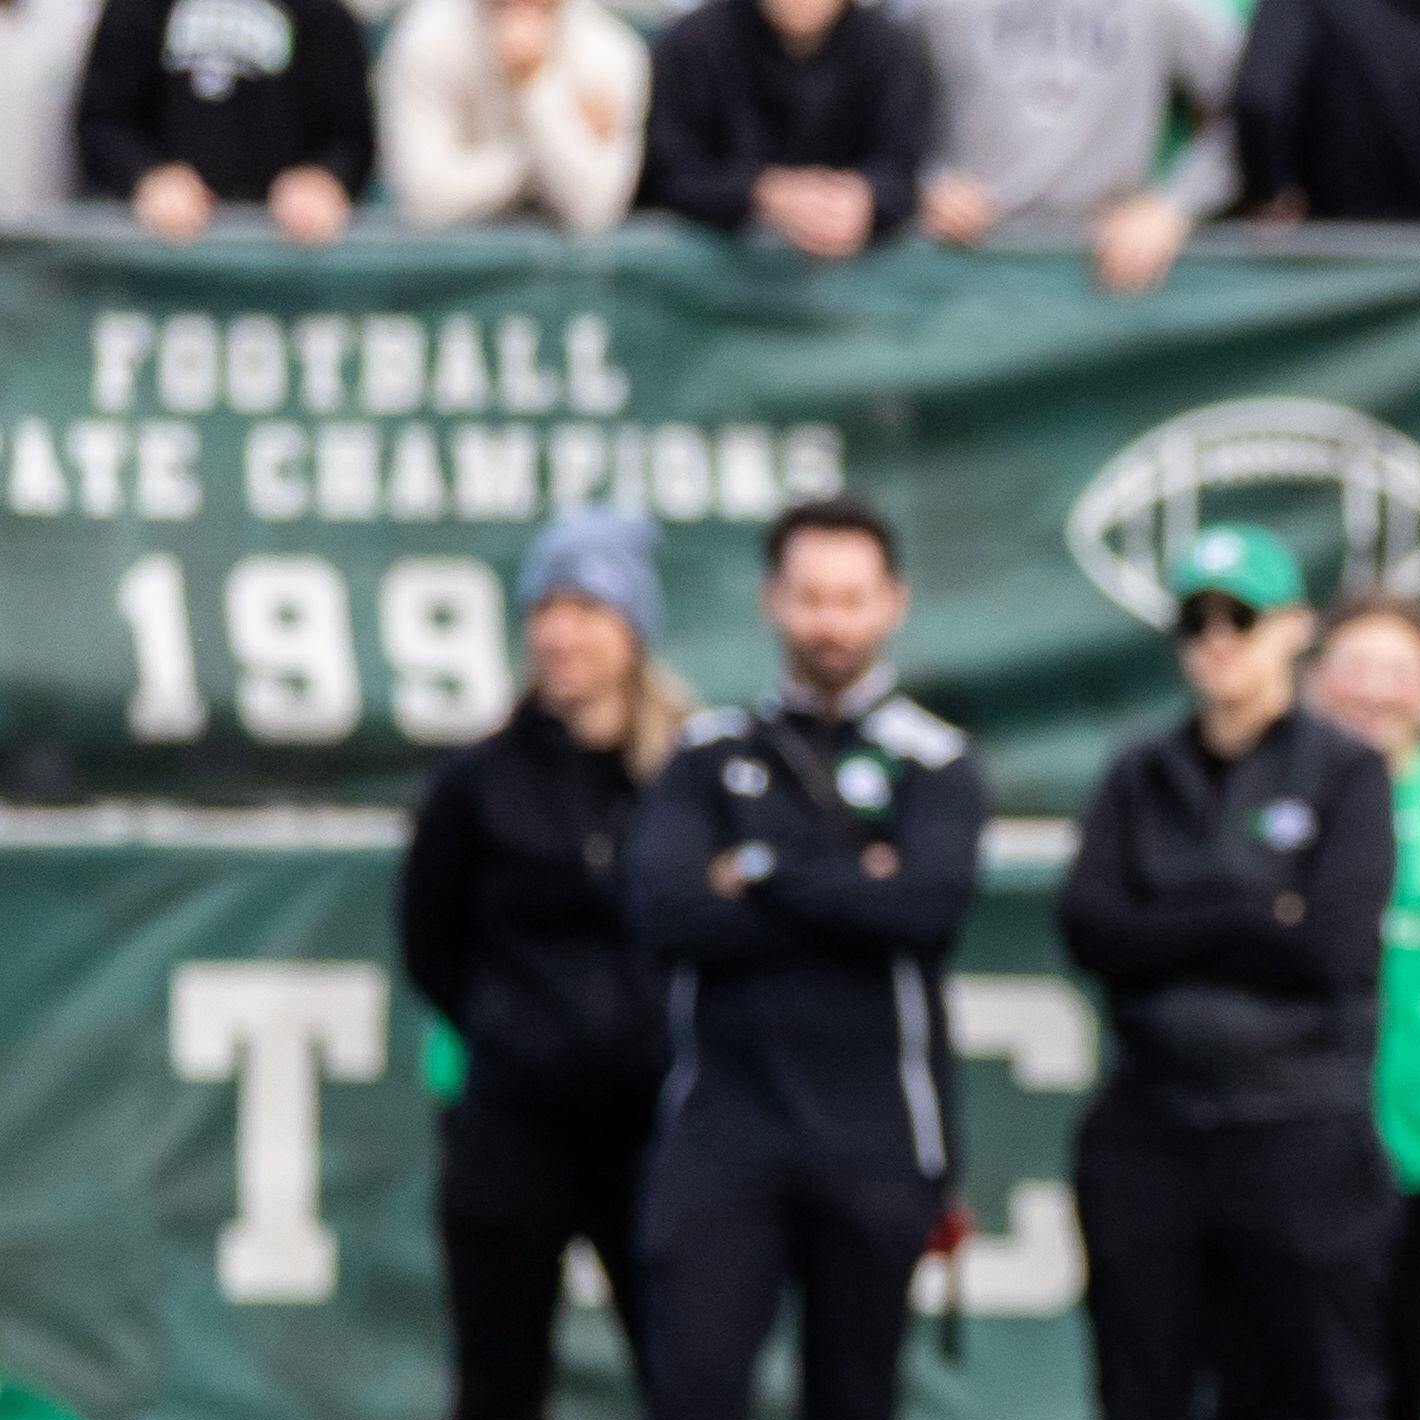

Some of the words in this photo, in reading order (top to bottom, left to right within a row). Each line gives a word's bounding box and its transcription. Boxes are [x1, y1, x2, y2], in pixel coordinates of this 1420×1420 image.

[90, 310, 632, 414] FOOTBALL
[2, 416, 201, 520] ATE
[243, 420, 845, 522] CHAMPIONS
[115, 552, 518, 745] 199
